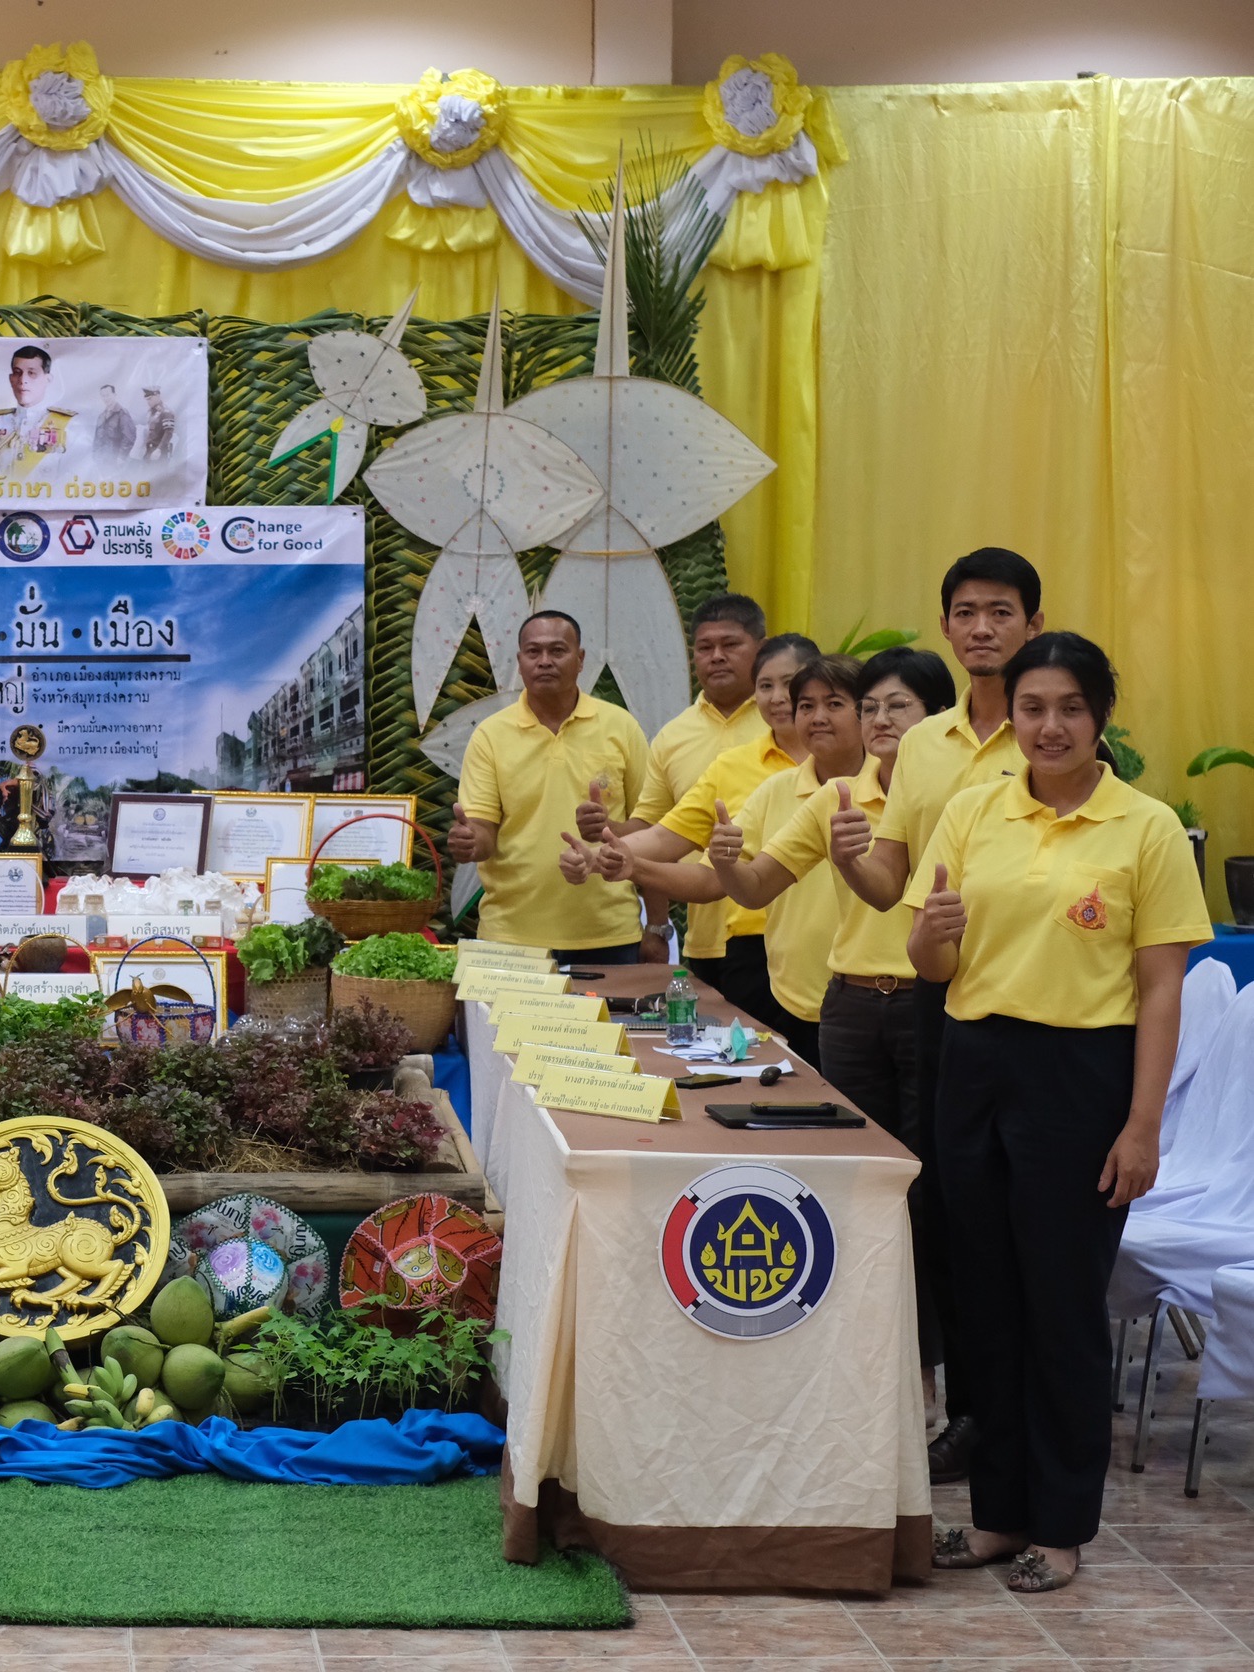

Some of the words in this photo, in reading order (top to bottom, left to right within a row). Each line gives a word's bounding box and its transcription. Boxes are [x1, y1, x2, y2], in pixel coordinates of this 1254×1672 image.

[64, 475, 151, 498] ต่อยอด
[103, 521, 152, 537] สานพลัง
[102, 539, 153, 559] ประชารัฐ
[257, 539, 283, 551] for
[286, 539, 323, 551] Good
[15, 586, 60, 649] มั่น
[94, 600, 174, 649] เมือง
[32, 689, 151, 710] จังหวัดสมุทรสงคราม
[57, 716, 163, 733] มีความมั่นคงทางอาหาร
[131, 921, 191, 936] เกลือสมทร
[11, 982, 89, 998] วัสดุสร้างมูลค่า
